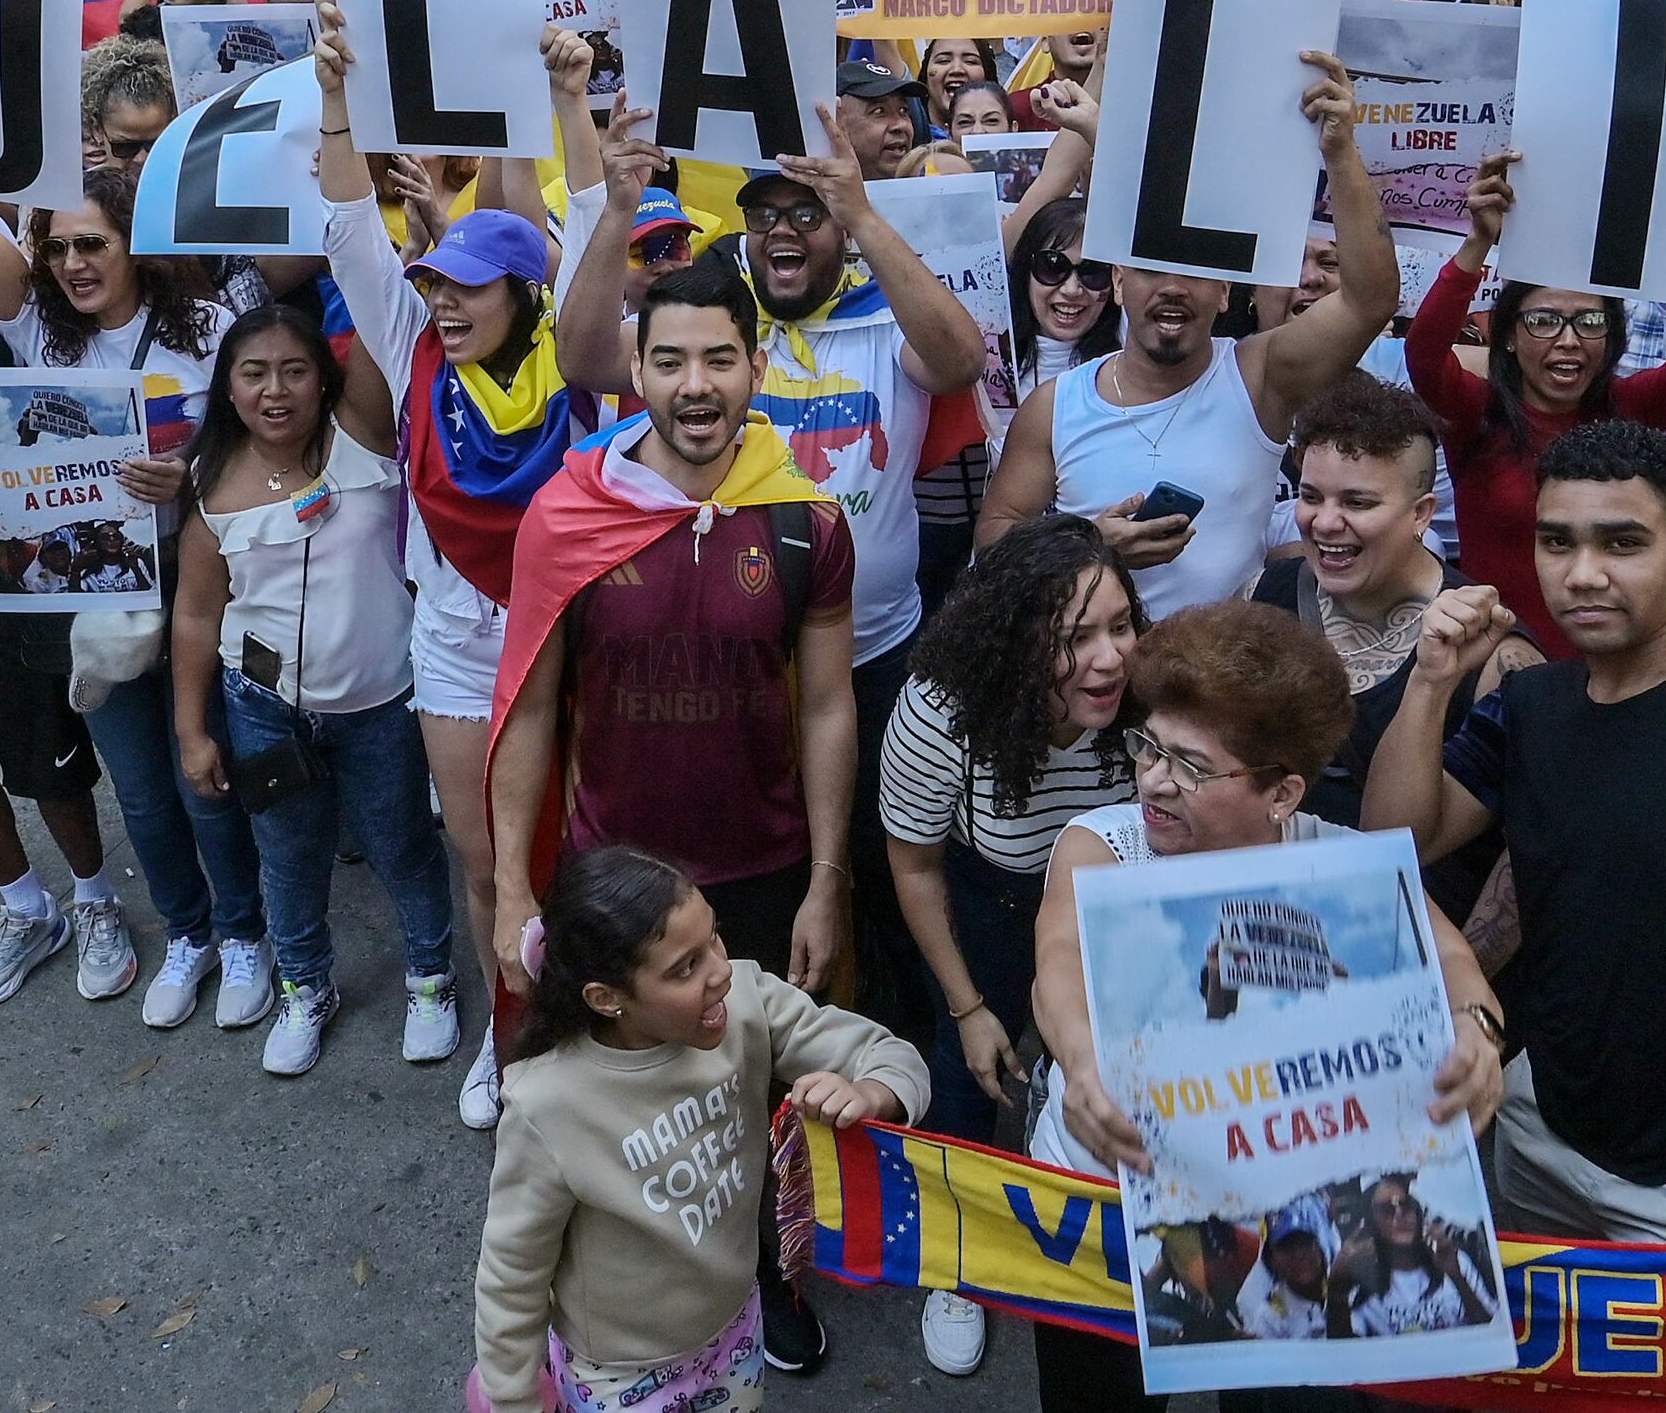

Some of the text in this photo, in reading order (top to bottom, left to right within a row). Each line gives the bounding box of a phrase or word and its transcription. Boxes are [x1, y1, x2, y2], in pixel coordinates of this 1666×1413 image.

[1353, 102, 1496, 124] VENEZUELA
[1391, 129, 1457, 151] LIBRE
[25, 484, 104, 511] A CASA
[612, 687, 721, 723] TENGO
[1146, 1031, 1404, 1122] VOLVEREMOS
[620, 1072, 742, 1172] MAMA'S
[1227, 1094, 1370, 1164] A CASA
[640, 1114, 746, 1215] COFFEE
[677, 1167, 746, 1248] DATE
